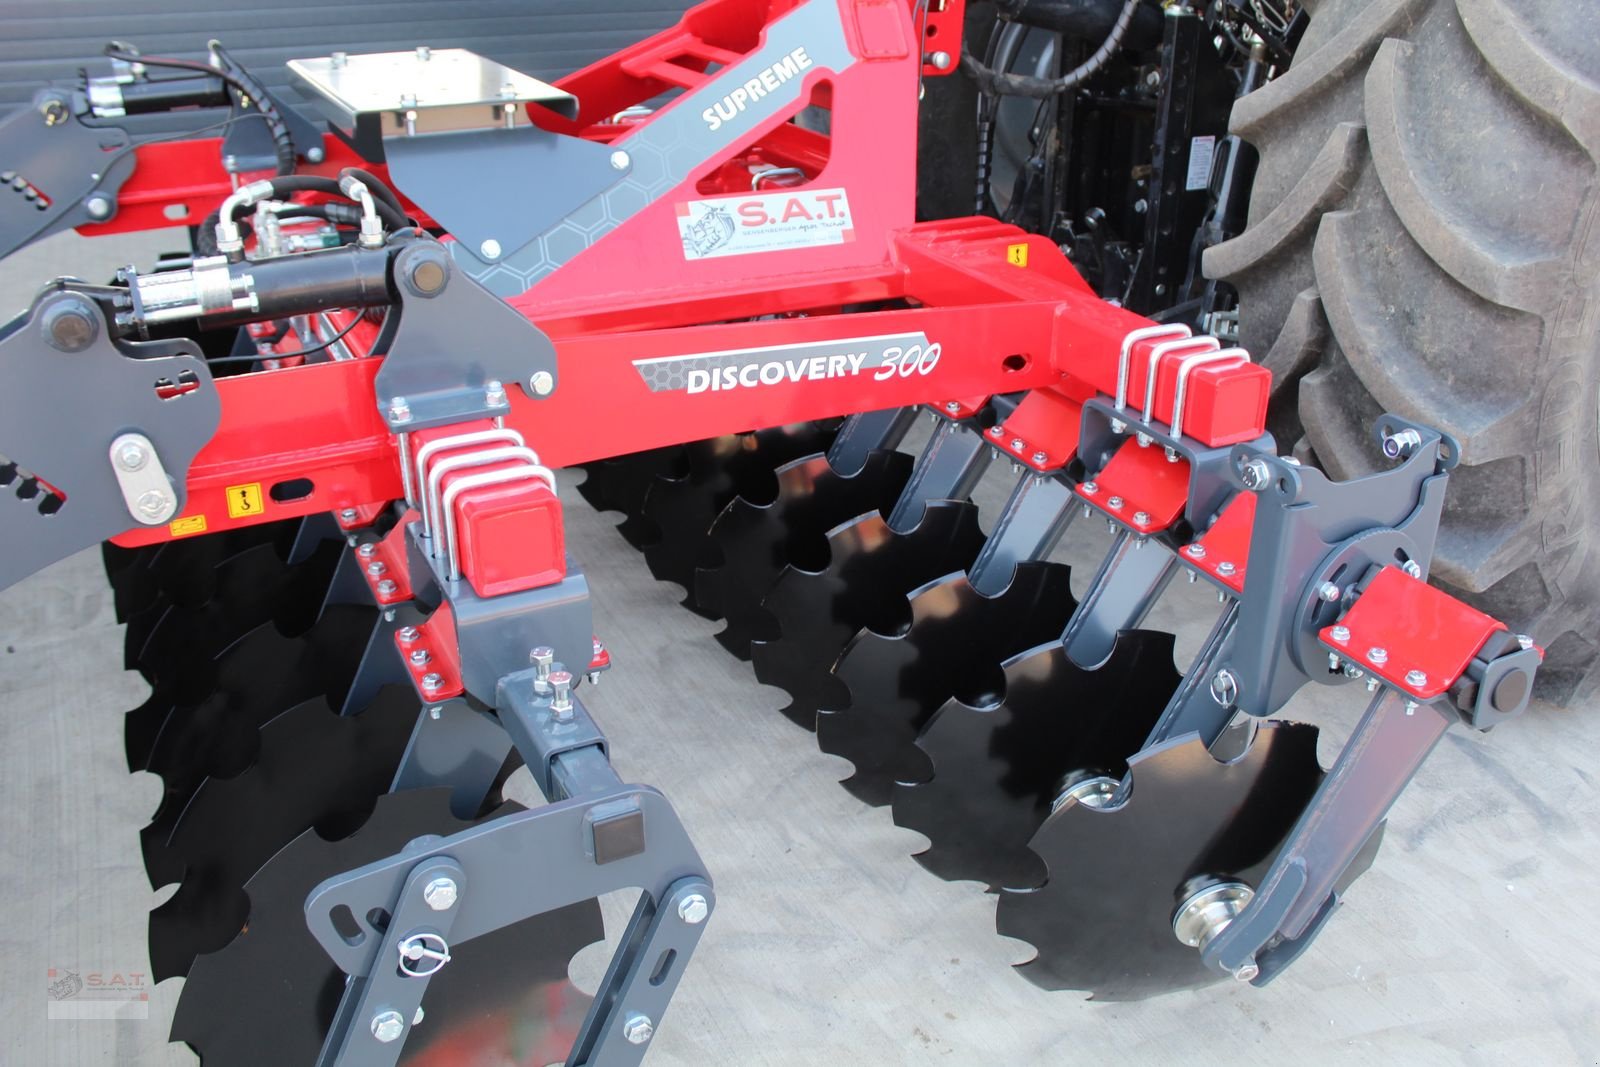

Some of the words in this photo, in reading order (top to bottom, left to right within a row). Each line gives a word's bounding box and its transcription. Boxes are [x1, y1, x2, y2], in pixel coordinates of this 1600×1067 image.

[703, 47, 812, 130] SUPREME
[737, 194, 845, 227] S.A.T.
[687, 352, 867, 394] DISCOVERY
[874, 342, 941, 381] 300
